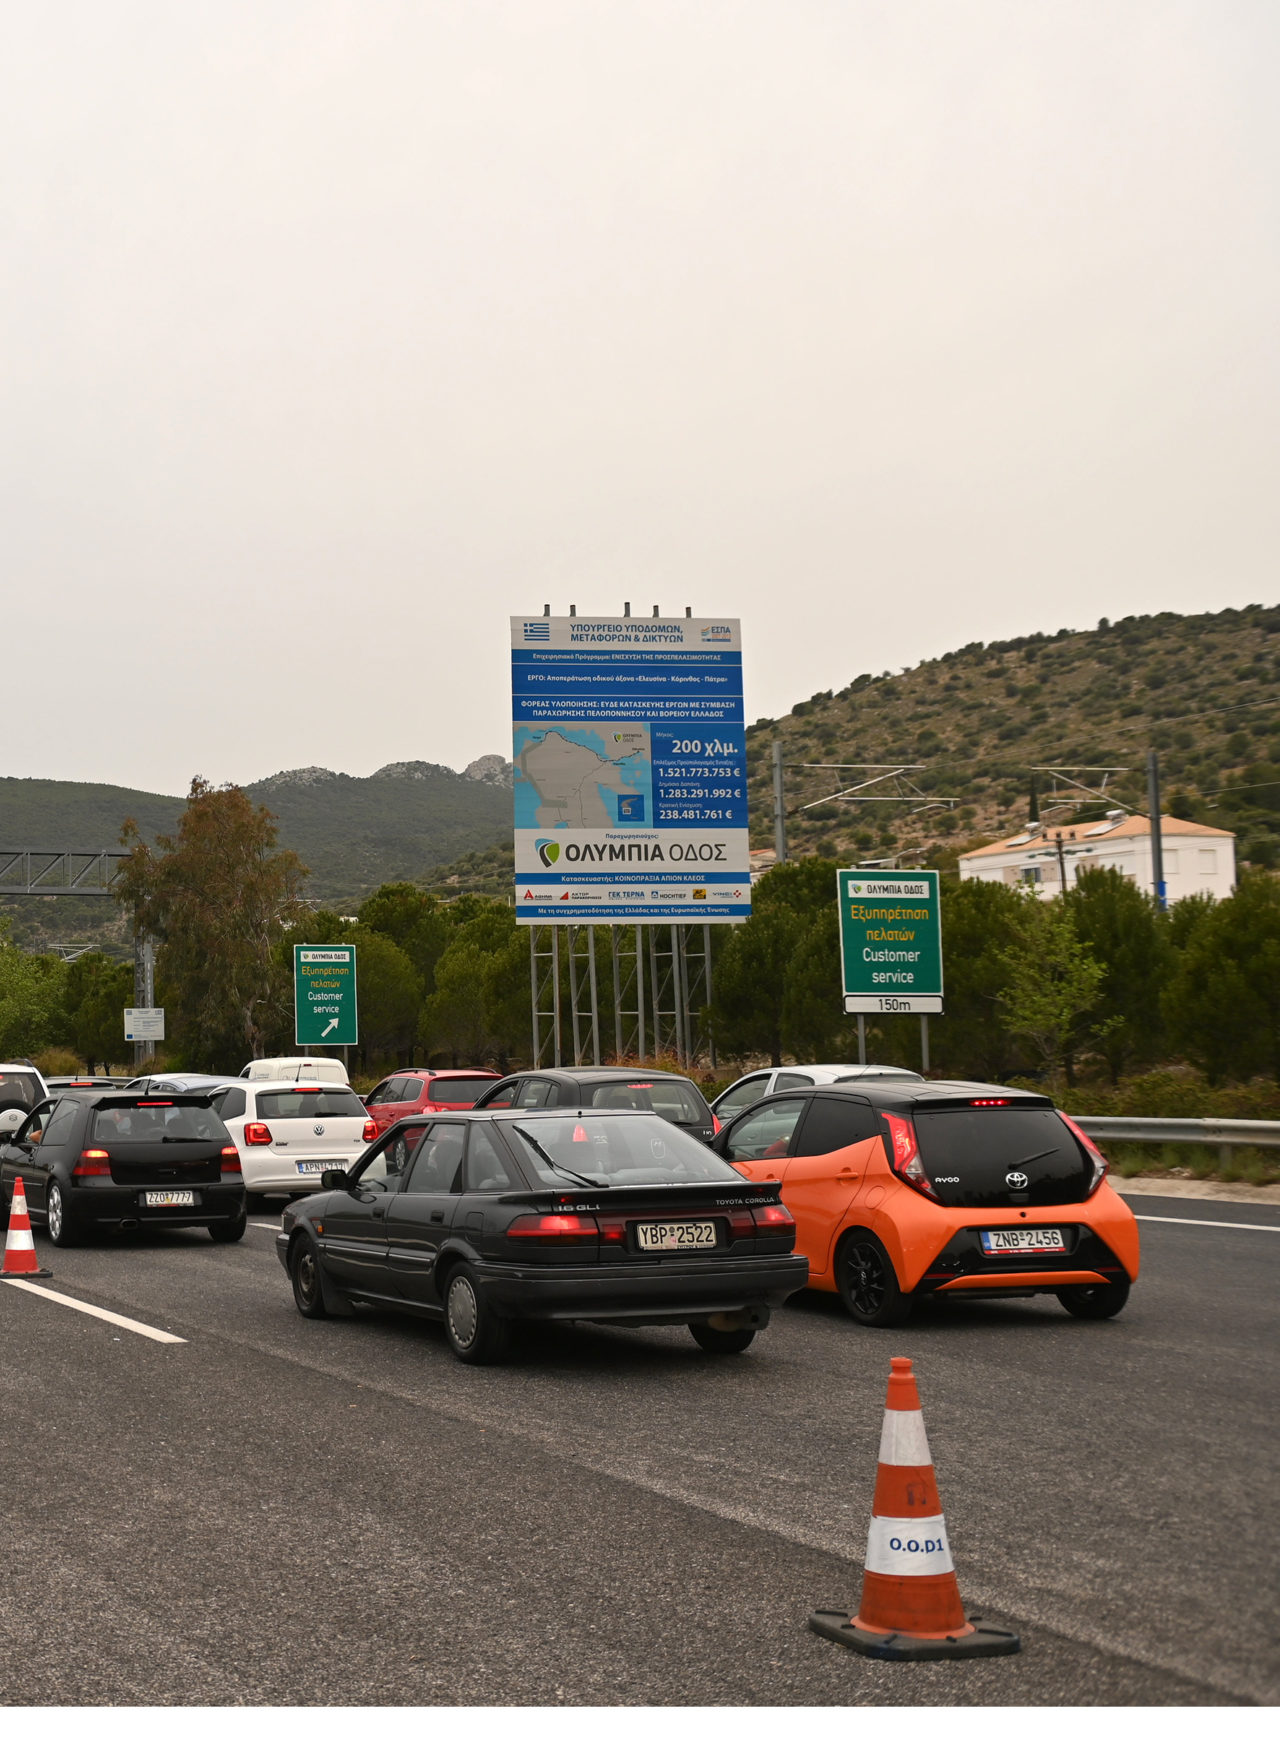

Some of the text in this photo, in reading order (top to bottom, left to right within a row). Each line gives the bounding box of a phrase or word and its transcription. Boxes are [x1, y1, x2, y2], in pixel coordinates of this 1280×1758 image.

[570, 624, 683, 634] ΥΠΟΥΡΓΕΙΟ ΥΠΟΔΟΜΩΝ,
[571, 633, 632, 642] ΜΕΤΑΦΟΡΩΝ
[642, 634, 684, 643] ΔΙΚΤΥΩΝ
[672, 739, 738, 757] 200 χλμ.
[659, 768, 741, 777] 1.521.773.753 €
[659, 789, 741, 798] 1.283.291.992 €
[659, 810, 733, 819] 238.481.761 €
[565, 844, 727, 861] ΟΛΥΜΠΙΑ ΟΔΟΣ
[867, 885, 924, 894] ΟΛΥΜΠΙΑ ΟΔΟΣ
[851, 905, 929, 923] Εξυπηρέτηση
[866, 927, 915, 941] πελατών
[863, 947, 921, 962] Customer
[872, 969, 914, 983] service
[308, 991, 343, 1001] Customer
[313, 1005, 339, 1013] service
[878, 999, 911, 1011] 150m
